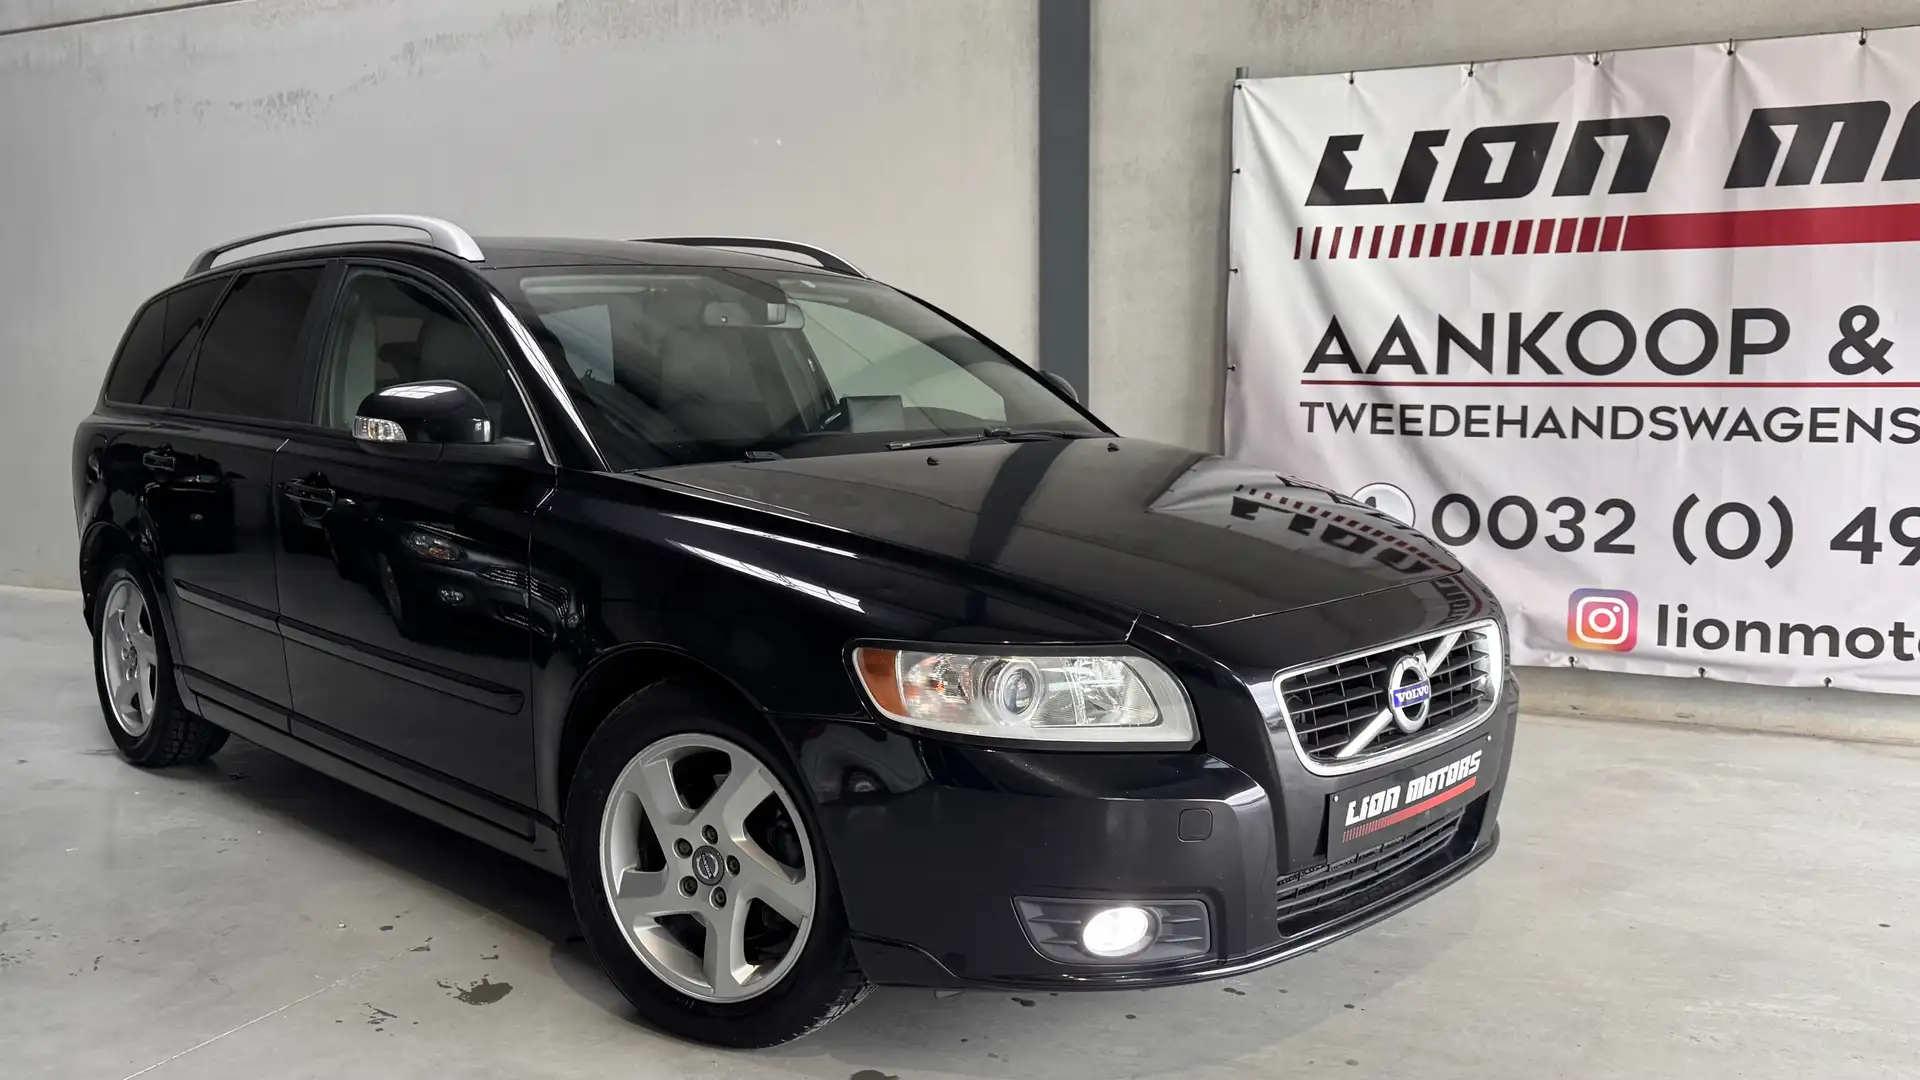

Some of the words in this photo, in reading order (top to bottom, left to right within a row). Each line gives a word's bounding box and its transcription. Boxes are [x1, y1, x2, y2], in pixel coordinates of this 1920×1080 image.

[1304, 115, 1671, 207] LION
[1303, 307, 1791, 376] AANKOOP
[1828, 304, 1894, 376] &
[1299, 401, 1920, 445] TWEEDEHANDSWAGENS
[1431, 492, 1636, 555] 0032
[1672, 493, 1793, 569] (0)
[1657, 604, 1920, 662] lionmot
[1395, 684, 1429, 703] VOLVO
[1344, 785, 1402, 827] LION
[1404, 749, 1483, 804] MOTORS
